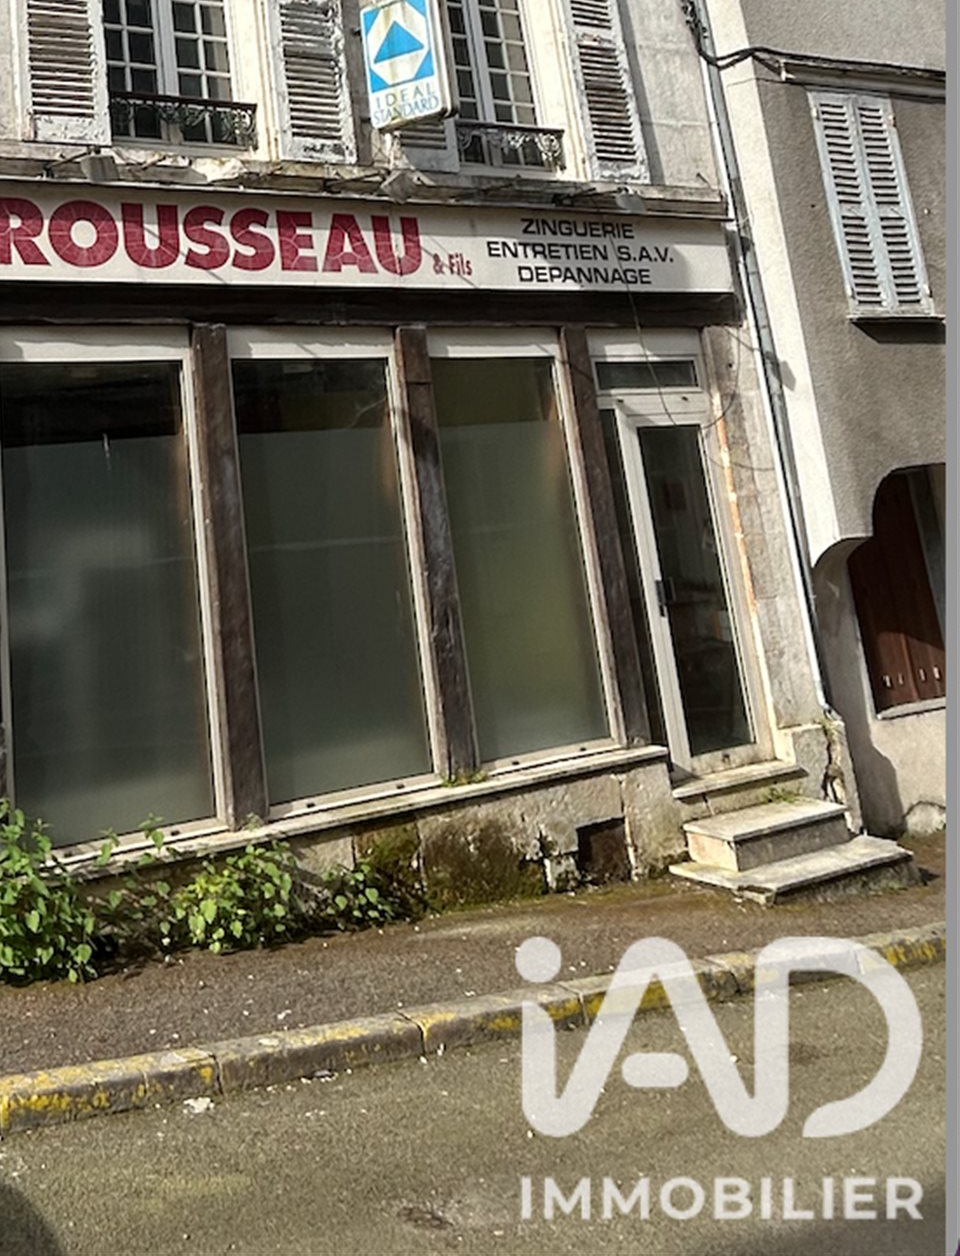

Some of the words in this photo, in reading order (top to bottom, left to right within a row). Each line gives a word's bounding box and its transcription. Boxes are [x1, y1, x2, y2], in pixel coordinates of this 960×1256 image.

[375, 82, 436, 109] IDEAL
[372, 95, 440, 126] STANDARD
[521, 218, 635, 239] ZINGUERIE
[487, 241, 608, 261] ENTRETIEN
[617, 246, 675, 263] S.A.V.
[432, 252, 443, 275] &
[447, 253, 473, 276] Fils
[518, 266, 652, 285] DEPANNAGE
